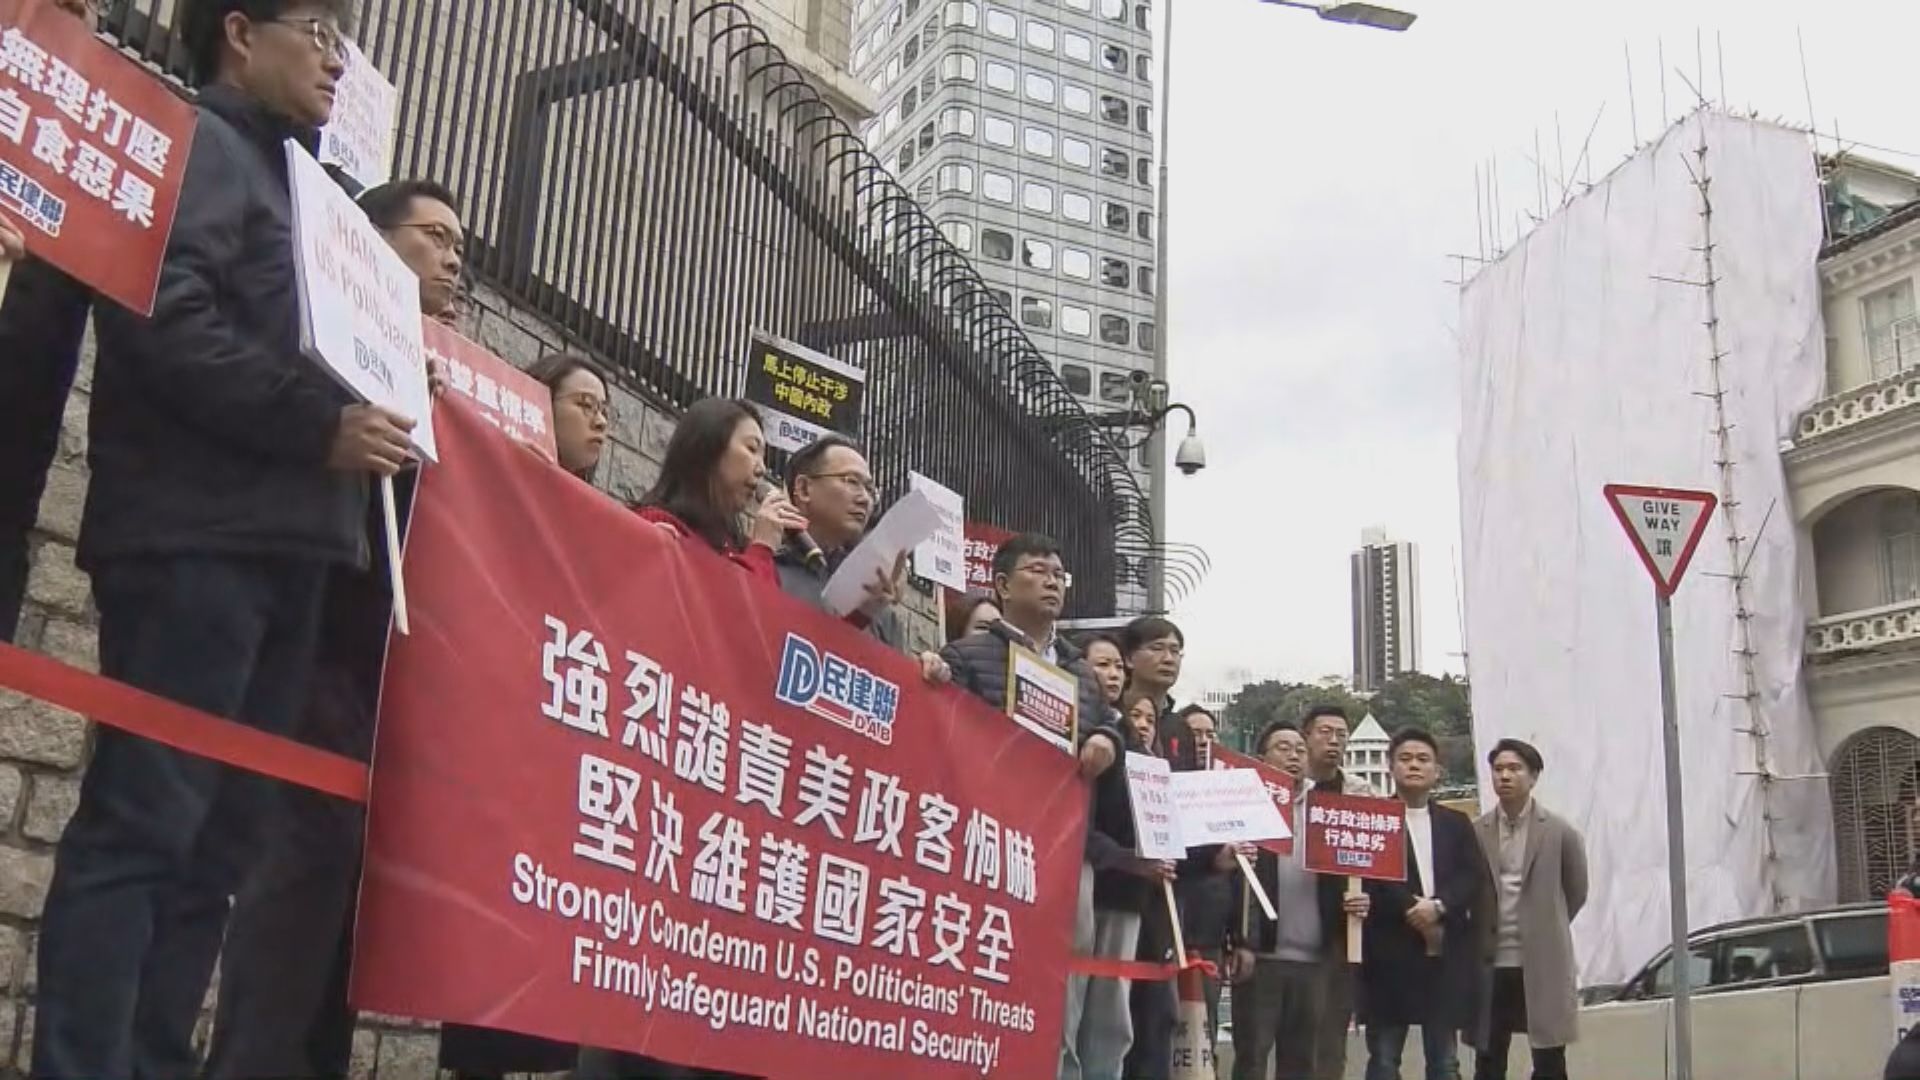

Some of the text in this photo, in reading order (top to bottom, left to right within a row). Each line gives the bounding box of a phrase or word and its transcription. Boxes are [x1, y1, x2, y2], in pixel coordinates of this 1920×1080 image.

[0, 28, 172, 178] 無理打壓
[0, 88, 156, 228] 自食惡果
[1643, 501, 1680, 515] GIVE
[1645, 517, 1680, 531] WAY
[541, 613, 1037, 903] 強烈譴責美政客恫嚇
[822, 652, 899, 724] 民建聯
[573, 753, 1014, 984] 堅決維護國家安全
[1310, 806, 1401, 834] 美方政治操弄
[1325, 828, 1386, 851] 行為卑劣
[512, 852, 1036, 1033] Strongly Condemn U.S. Politicians' Threats
[572, 935, 1001, 1076] Firmly Safeguard National Security!
